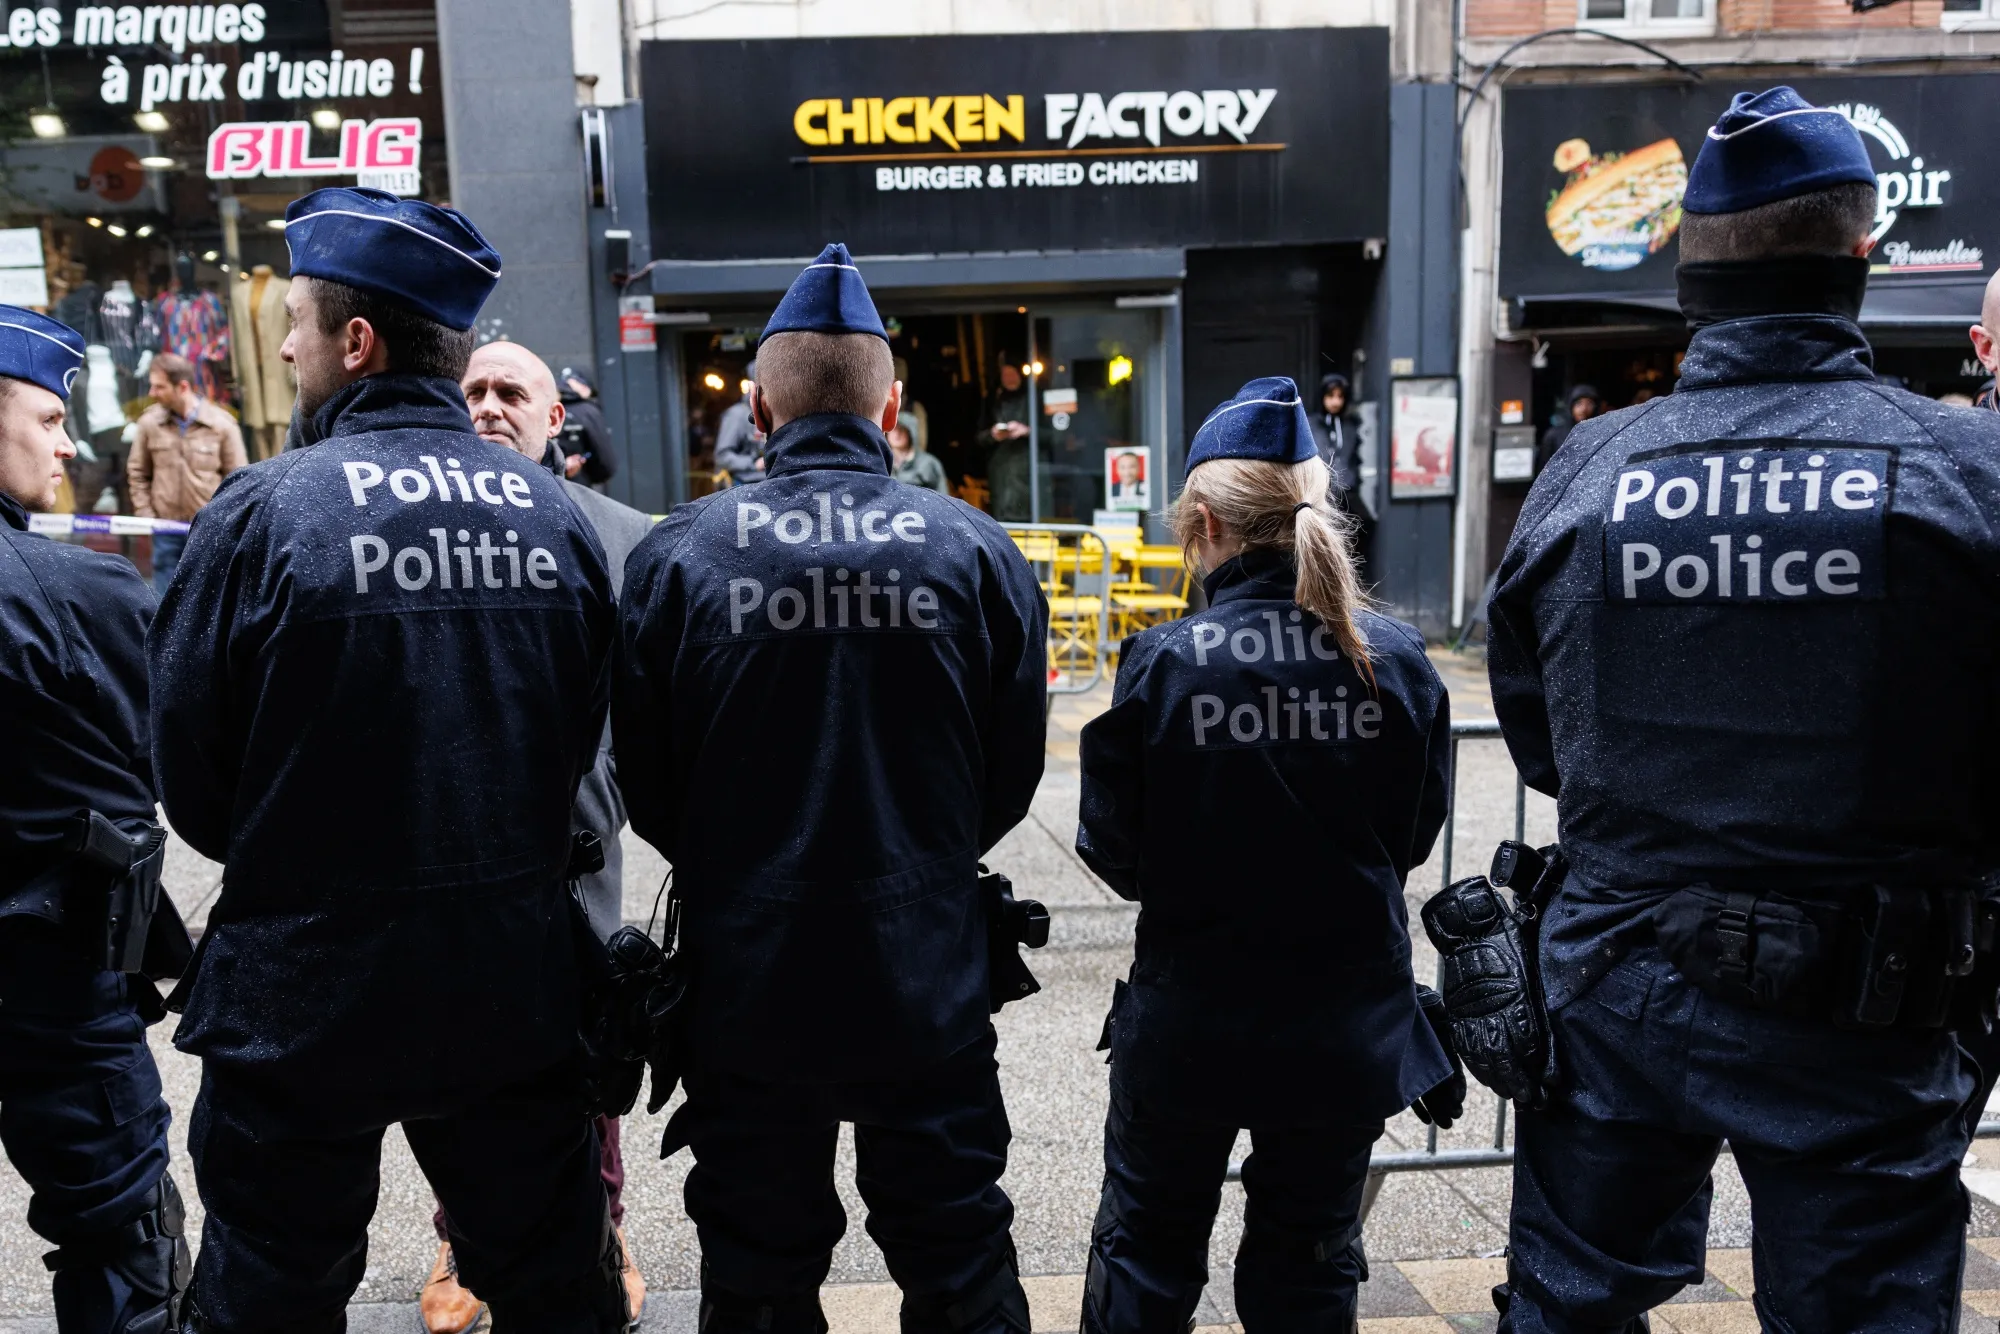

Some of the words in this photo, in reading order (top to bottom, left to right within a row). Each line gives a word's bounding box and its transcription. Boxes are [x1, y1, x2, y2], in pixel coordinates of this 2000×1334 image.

[73, 3, 267, 53] marques
[100, 55, 129, 103] à
[140, 53, 227, 112] prix
[409, 47, 424, 94] !
[209, 120, 419, 176] BILIG
[793, 93, 1025, 151] CHICKEN
[1044, 88, 1278, 149] FACTORY
[876, 165, 983, 191] BURGER
[986, 164, 1007, 188] &
[1011, 162, 1085, 188] FRIED
[1088, 159, 1199, 186] CHICKEN
[1876, 156, 1951, 222] pir
[1883, 238, 1983, 266] Bruxelles
[342, 456, 534, 508] Police
[1612, 454, 1880, 522] Politie
[737, 492, 926, 548] Police
[349, 528, 558, 594] Politie
[1622, 534, 1861, 599] Police
[729, 567, 939, 634] Politie
[1191, 686, 1383, 746] Politie
